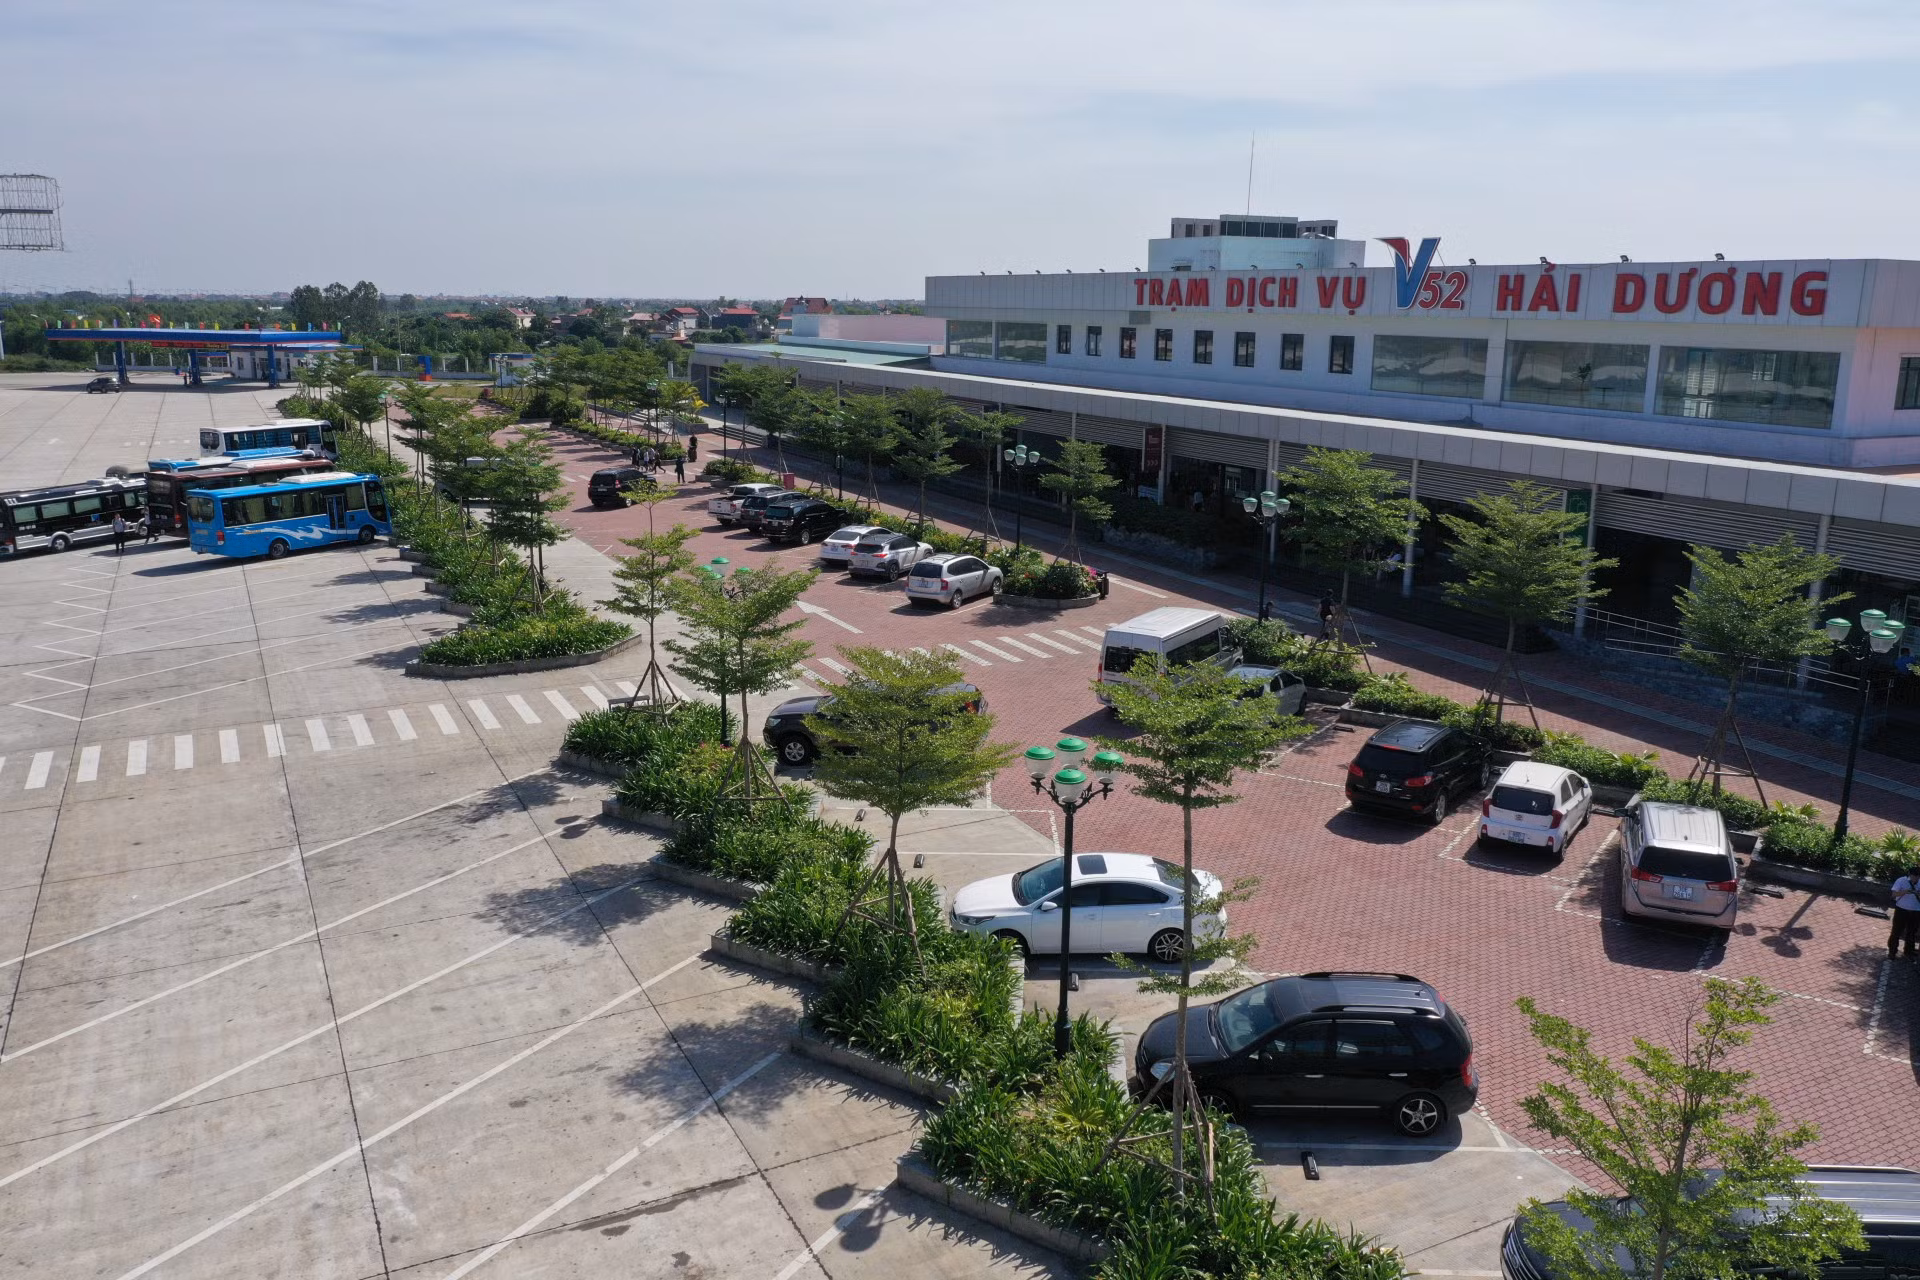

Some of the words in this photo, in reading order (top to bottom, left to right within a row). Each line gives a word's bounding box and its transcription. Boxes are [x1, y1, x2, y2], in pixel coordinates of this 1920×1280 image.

[1134, 278, 1210, 312] TRẠM
[1225, 276, 1298, 313] DỊCH
[1316, 276, 1367, 315] VỤ
[1496, 261, 1582, 312] HẢI
[1612, 267, 1828, 316] DƯƠNG
